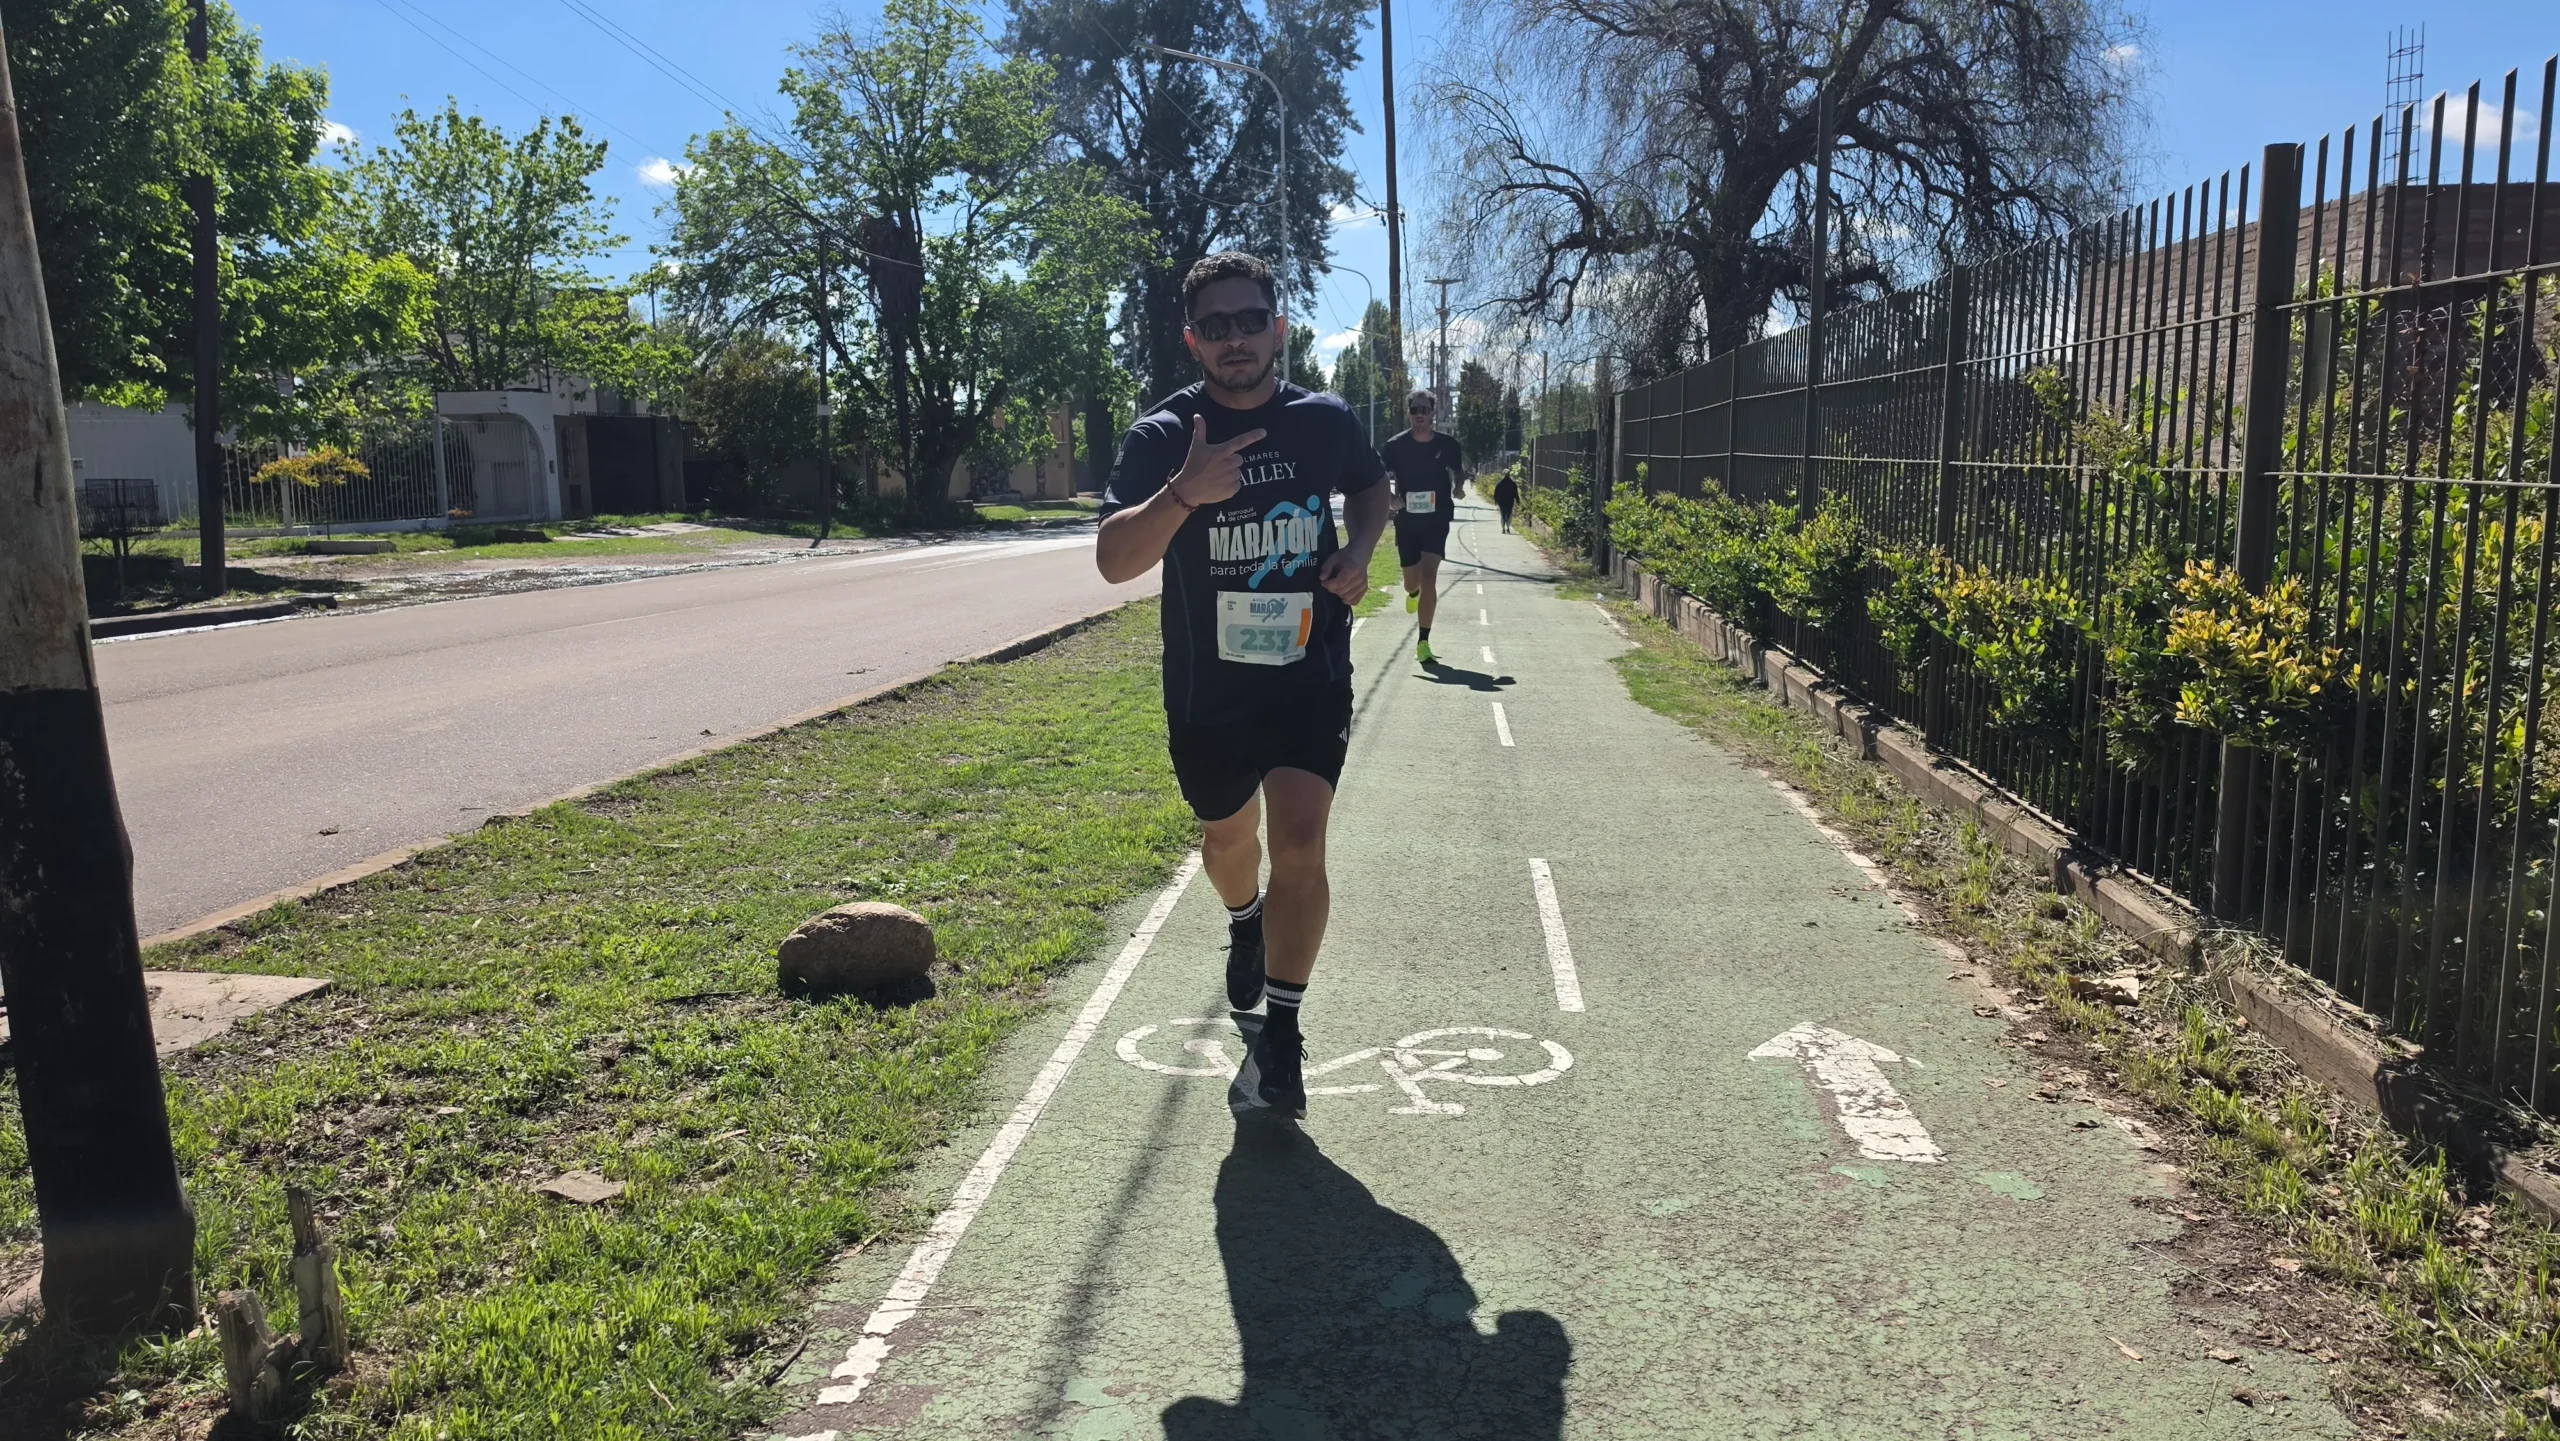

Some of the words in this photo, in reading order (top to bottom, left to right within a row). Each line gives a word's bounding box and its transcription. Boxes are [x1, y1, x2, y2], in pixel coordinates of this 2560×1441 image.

[1244, 451, 1280, 463] LMARES
[1240, 462, 1297, 486] ALLEY
[1209, 508, 1318, 562] MARATÓN
[1210, 565, 1237, 576] para
[1239, 561, 1265, 575] toda
[1268, 560, 1278, 570] la
[1280, 556, 1318, 570] familia
[1240, 628, 1291, 653] 233
